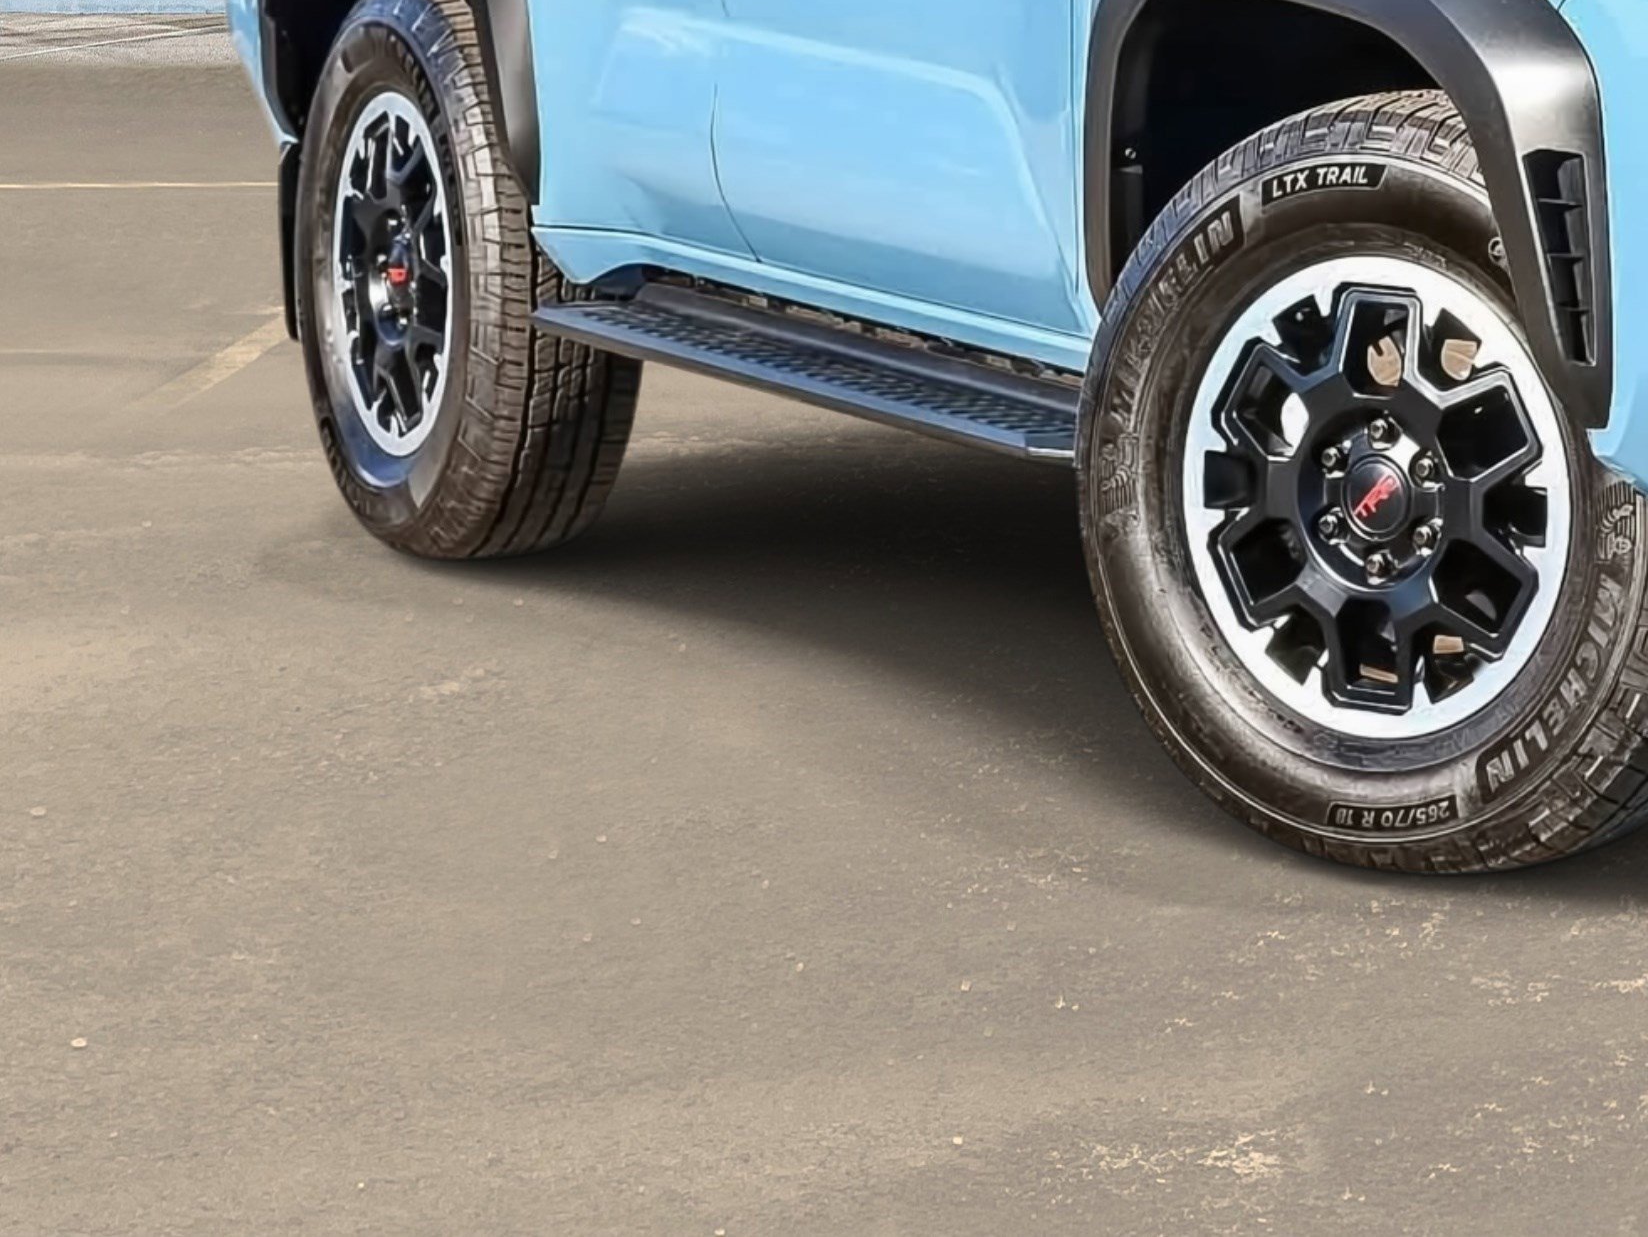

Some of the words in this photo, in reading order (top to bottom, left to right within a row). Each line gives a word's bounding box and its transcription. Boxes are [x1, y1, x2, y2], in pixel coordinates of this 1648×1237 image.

[1273, 169, 1310, 198] LTX
[1316, 165, 1368, 186] TRAIL
[1361, 810, 1375, 828] R
[1380, 800, 1450, 828] 265/70
